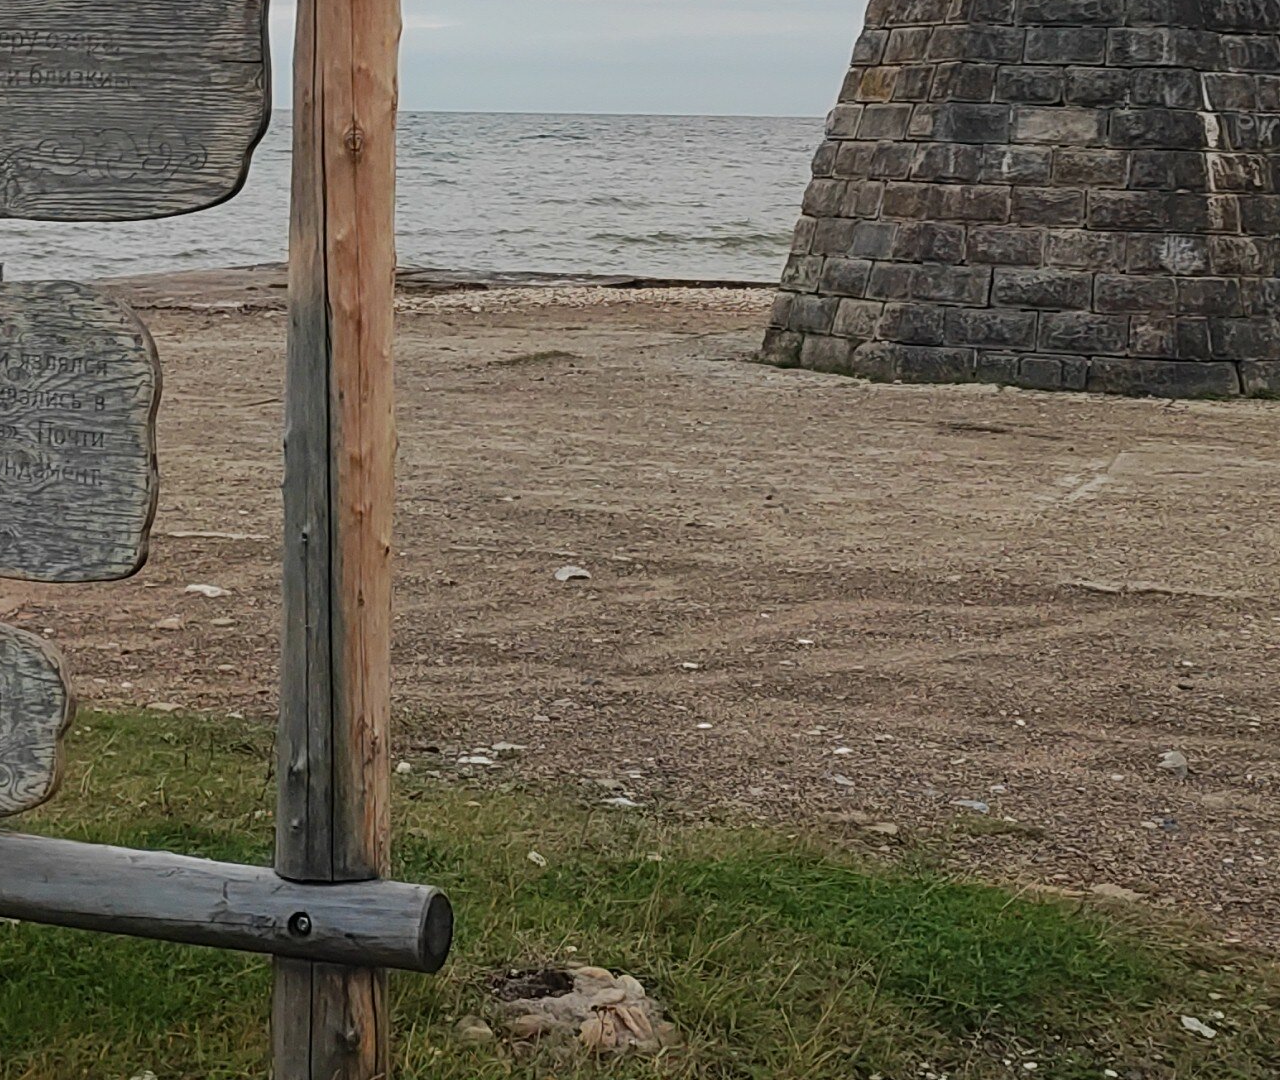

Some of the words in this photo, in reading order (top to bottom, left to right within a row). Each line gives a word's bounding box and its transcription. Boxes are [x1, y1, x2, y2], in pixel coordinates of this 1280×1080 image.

[19, 353, 108, 378] являлся
[94, 397, 107, 413] в
[37, 420, 106, 449] Почти
